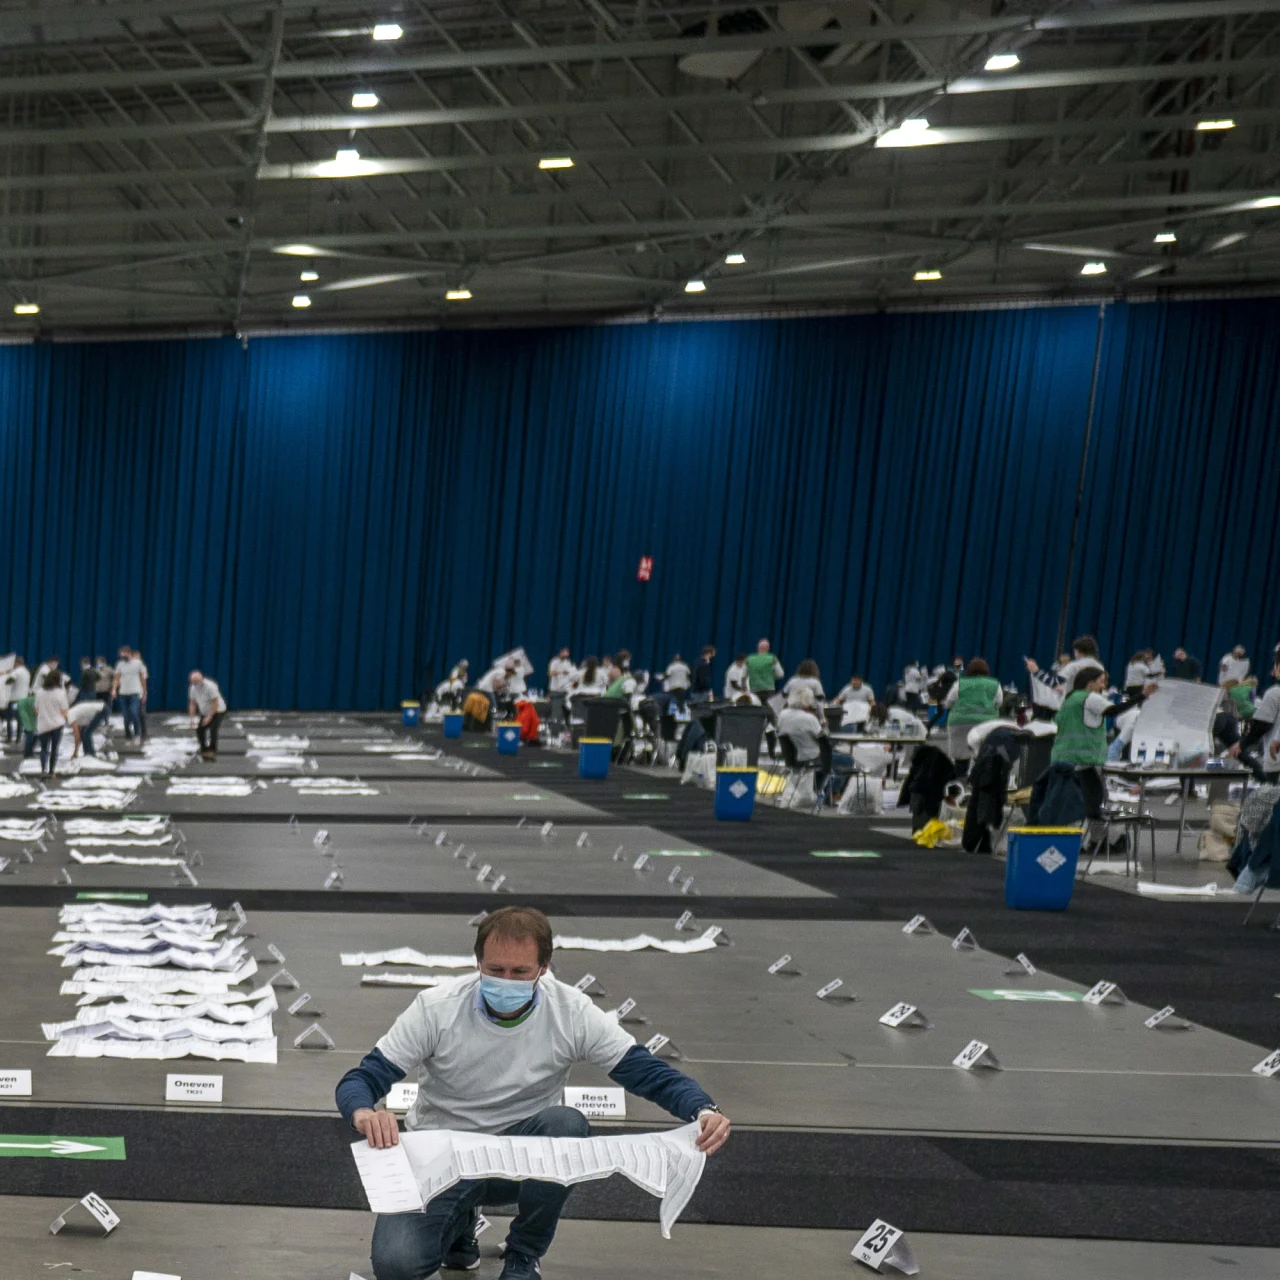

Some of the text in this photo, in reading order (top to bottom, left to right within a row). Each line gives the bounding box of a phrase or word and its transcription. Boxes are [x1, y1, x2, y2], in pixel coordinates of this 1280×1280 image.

[174, 1080, 215, 1089] Oneven
[581, 1094, 608, 1102] Rest
[86, 1195, 110, 1219] 13
[862, 1224, 897, 1255] 25
[861, 1252, 872, 1263] TK21
